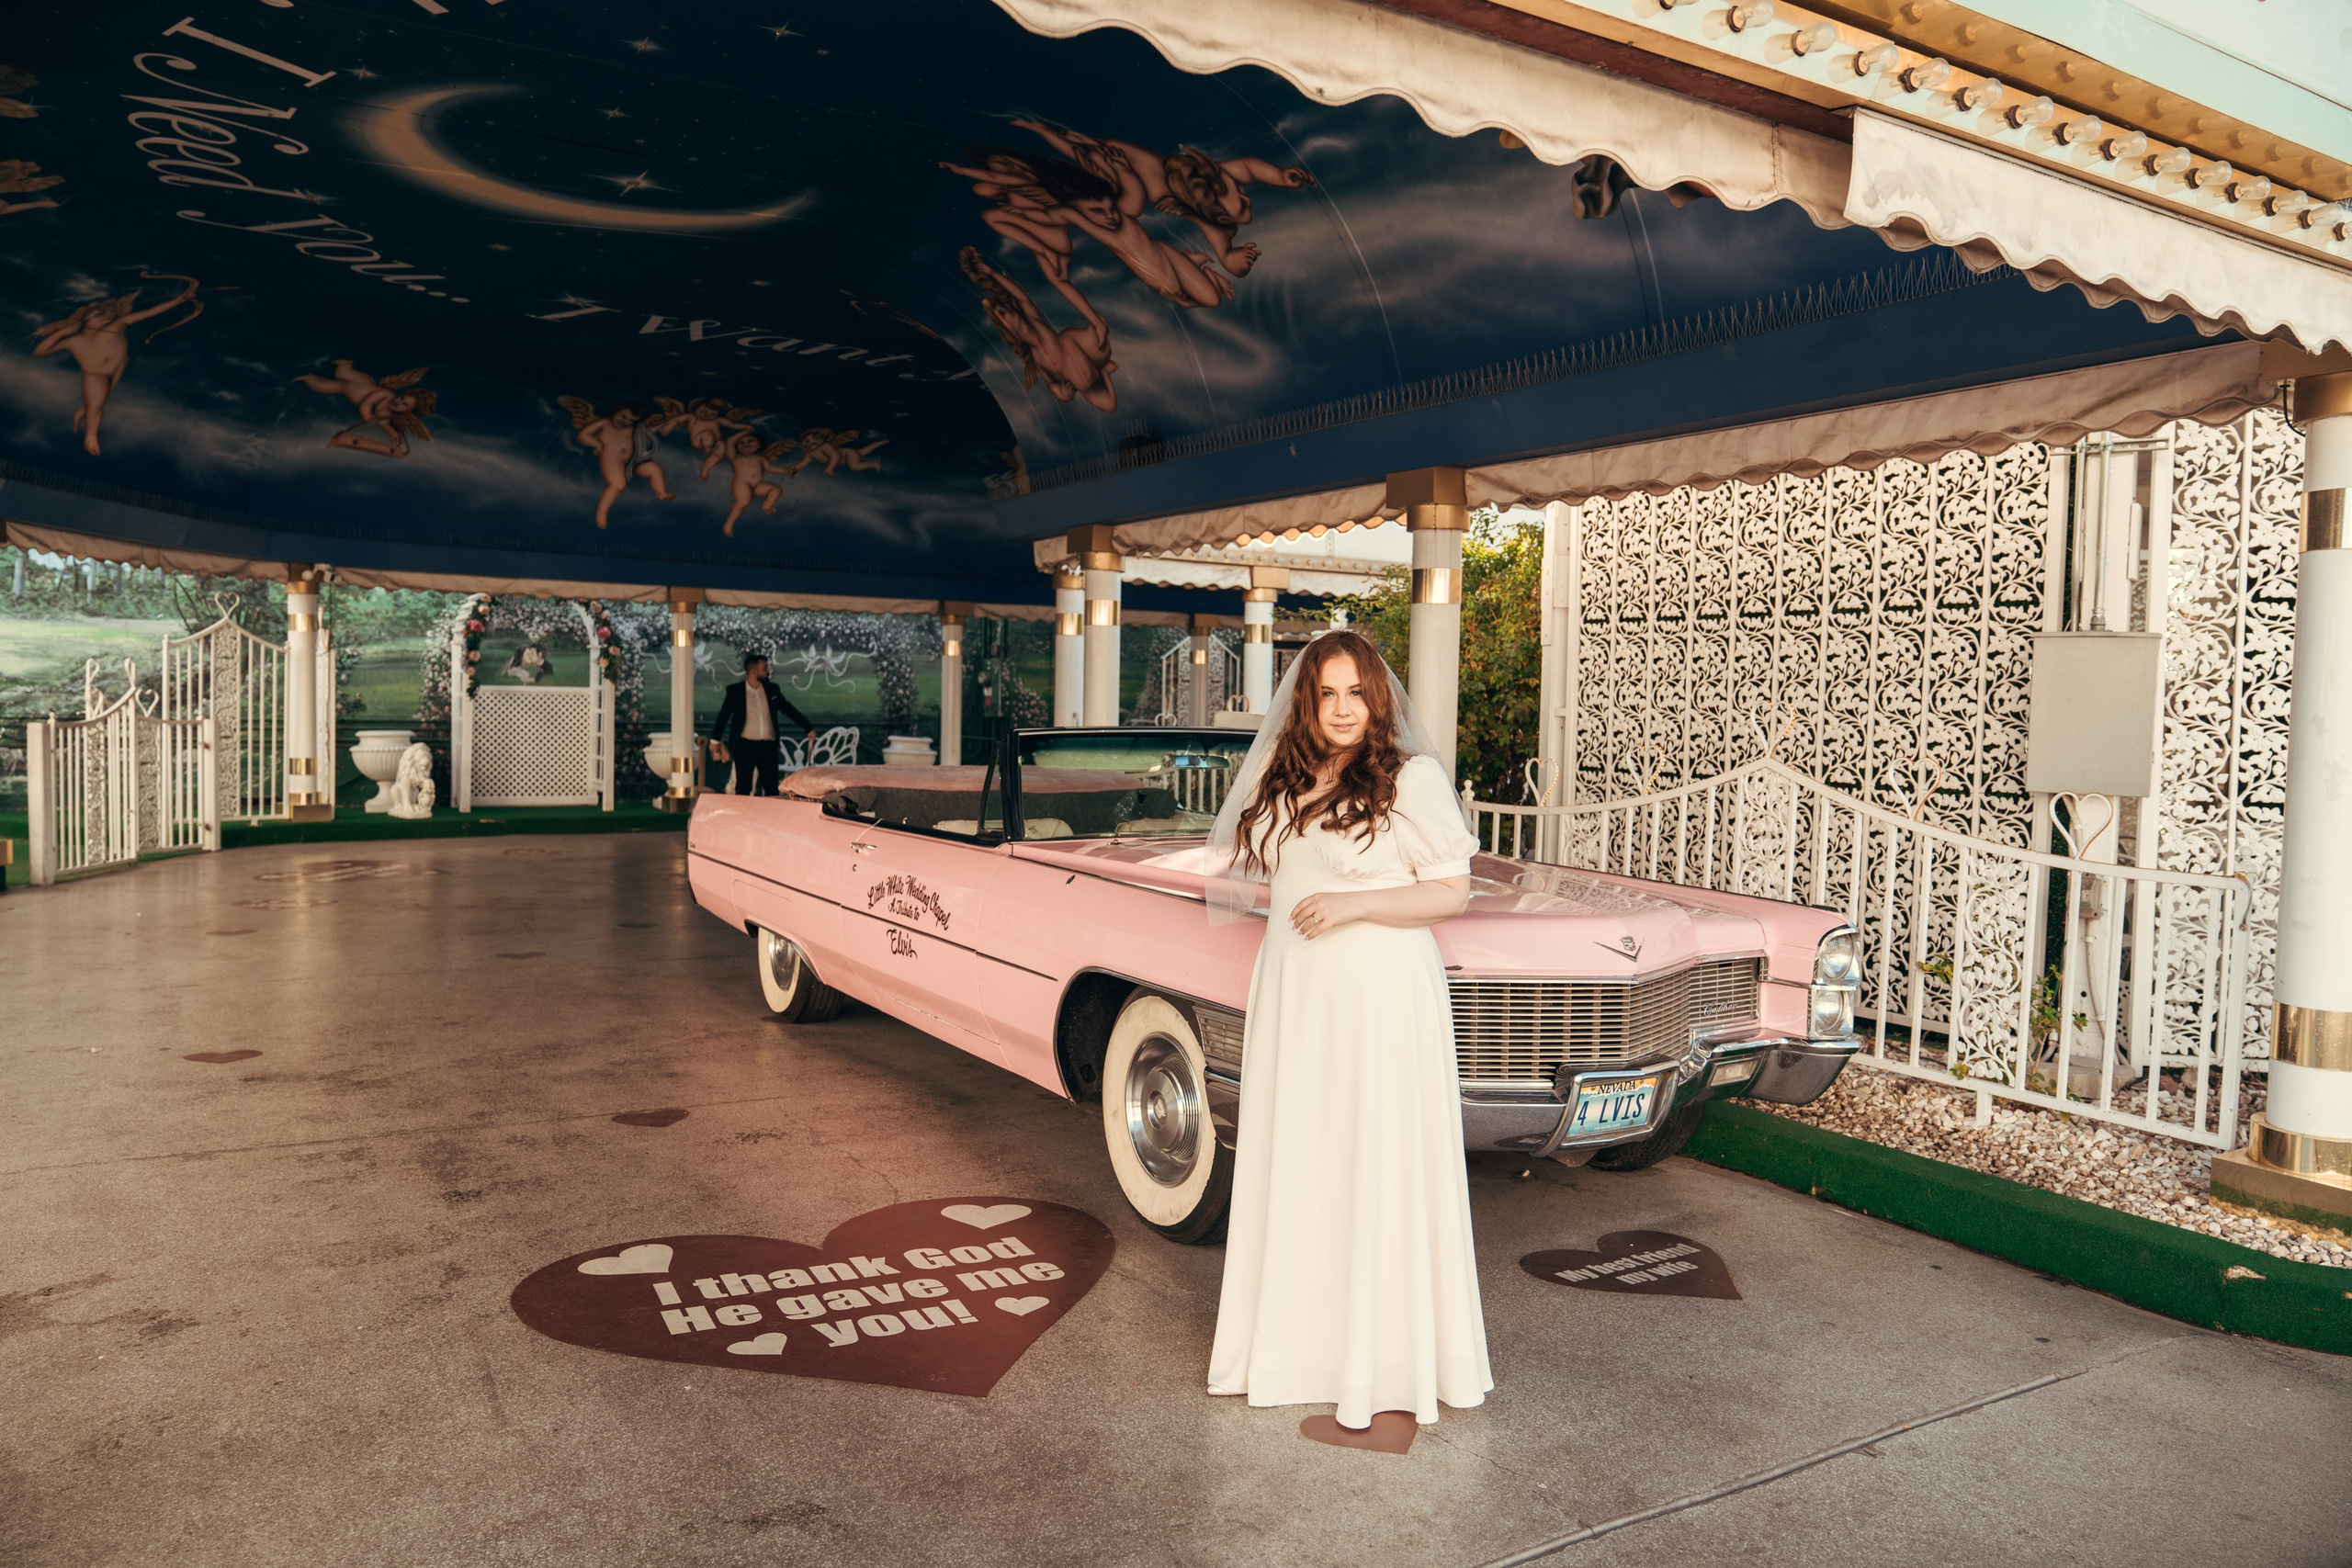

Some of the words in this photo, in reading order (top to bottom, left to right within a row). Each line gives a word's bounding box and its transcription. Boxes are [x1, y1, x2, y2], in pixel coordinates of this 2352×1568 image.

[162, 17, 337, 87] I
[119, 52, 318, 199] Need
[638, 313, 914, 367] Want
[867, 881, 885, 909] Little
[886, 874, 904, 896] White
[906, 875, 930, 913] Wedding
[930, 892, 951, 931] Chapel
[888, 897, 896, 913] A
[896, 899, 913, 919] Tribute
[913, 907, 921, 921] to
[886, 929, 918, 960] Elvis
[1577, 1100, 1589, 1126] 4
[1599, 1093, 1645, 1124] LVIS
[1597, 1080, 1636, 1095] NEVADA
[651, 1281, 683, 1306] I
[692, 1256, 901, 1302] thank
[903, 1236, 1036, 1270] God
[1554, 1264, 1599, 1283] My
[1589, 1254, 1640, 1275] best
[1631, 1242, 1702, 1265] friend
[1615, 1267, 1658, 1285] my
[1648, 1260, 1699, 1278] wife
[660, 1299, 762, 1336] He
[777, 1277, 949, 1320] gave
[956, 1260, 1066, 1292] me
[810, 1300, 979, 1348] you!
